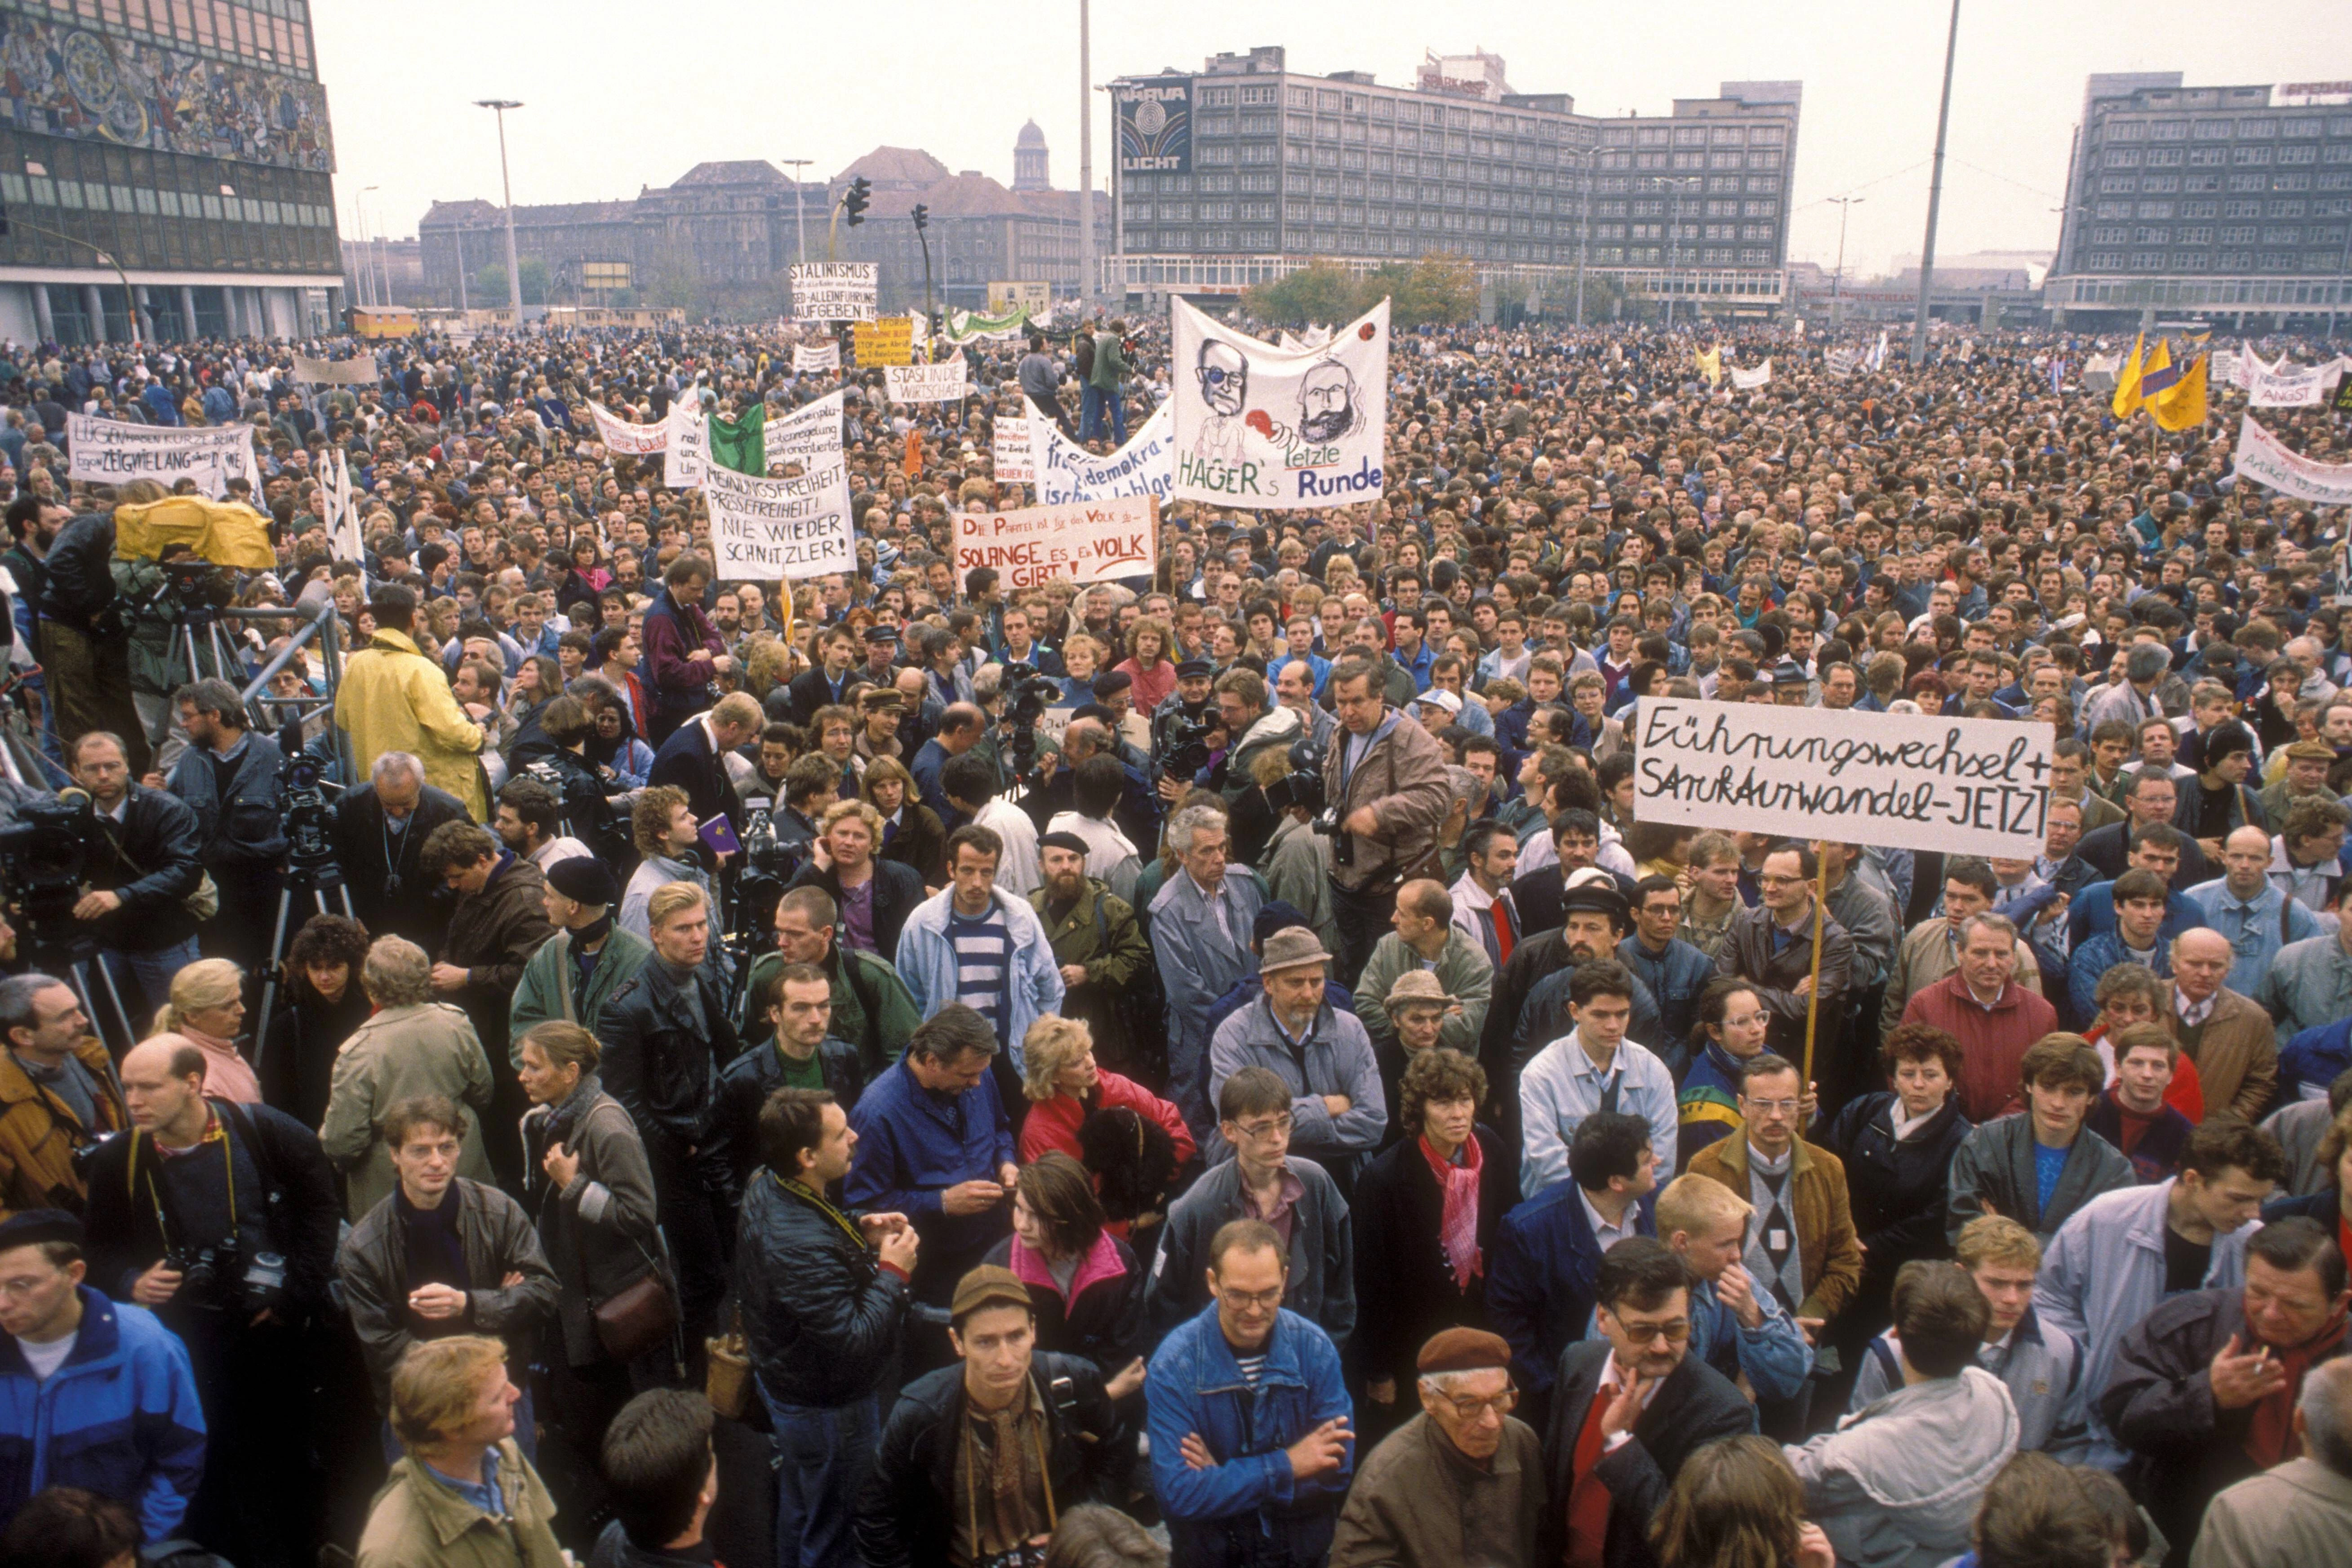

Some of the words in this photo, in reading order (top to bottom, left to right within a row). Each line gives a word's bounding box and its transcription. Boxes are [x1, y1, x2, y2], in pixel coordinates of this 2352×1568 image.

[1122, 156, 1181, 169] LICHT
[789, 263, 869, 279] STALINISMUS
[796, 303, 861, 319] AUFGEBEN
[891, 367, 925, 382] STASI
[900, 382, 965, 399] WIRTSCHAFT
[2261, 387, 2310, 401] ANGST
[1298, 455, 1383, 498] Runde
[1086, 510, 1115, 523] VOLK
[723, 517, 755, 538] NIE
[765, 514, 842, 542] WIEDER
[959, 542, 1042, 569] SOLANGE
[1093, 533, 1146, 559] VOLK
[1012, 564, 1061, 587] GIBT
